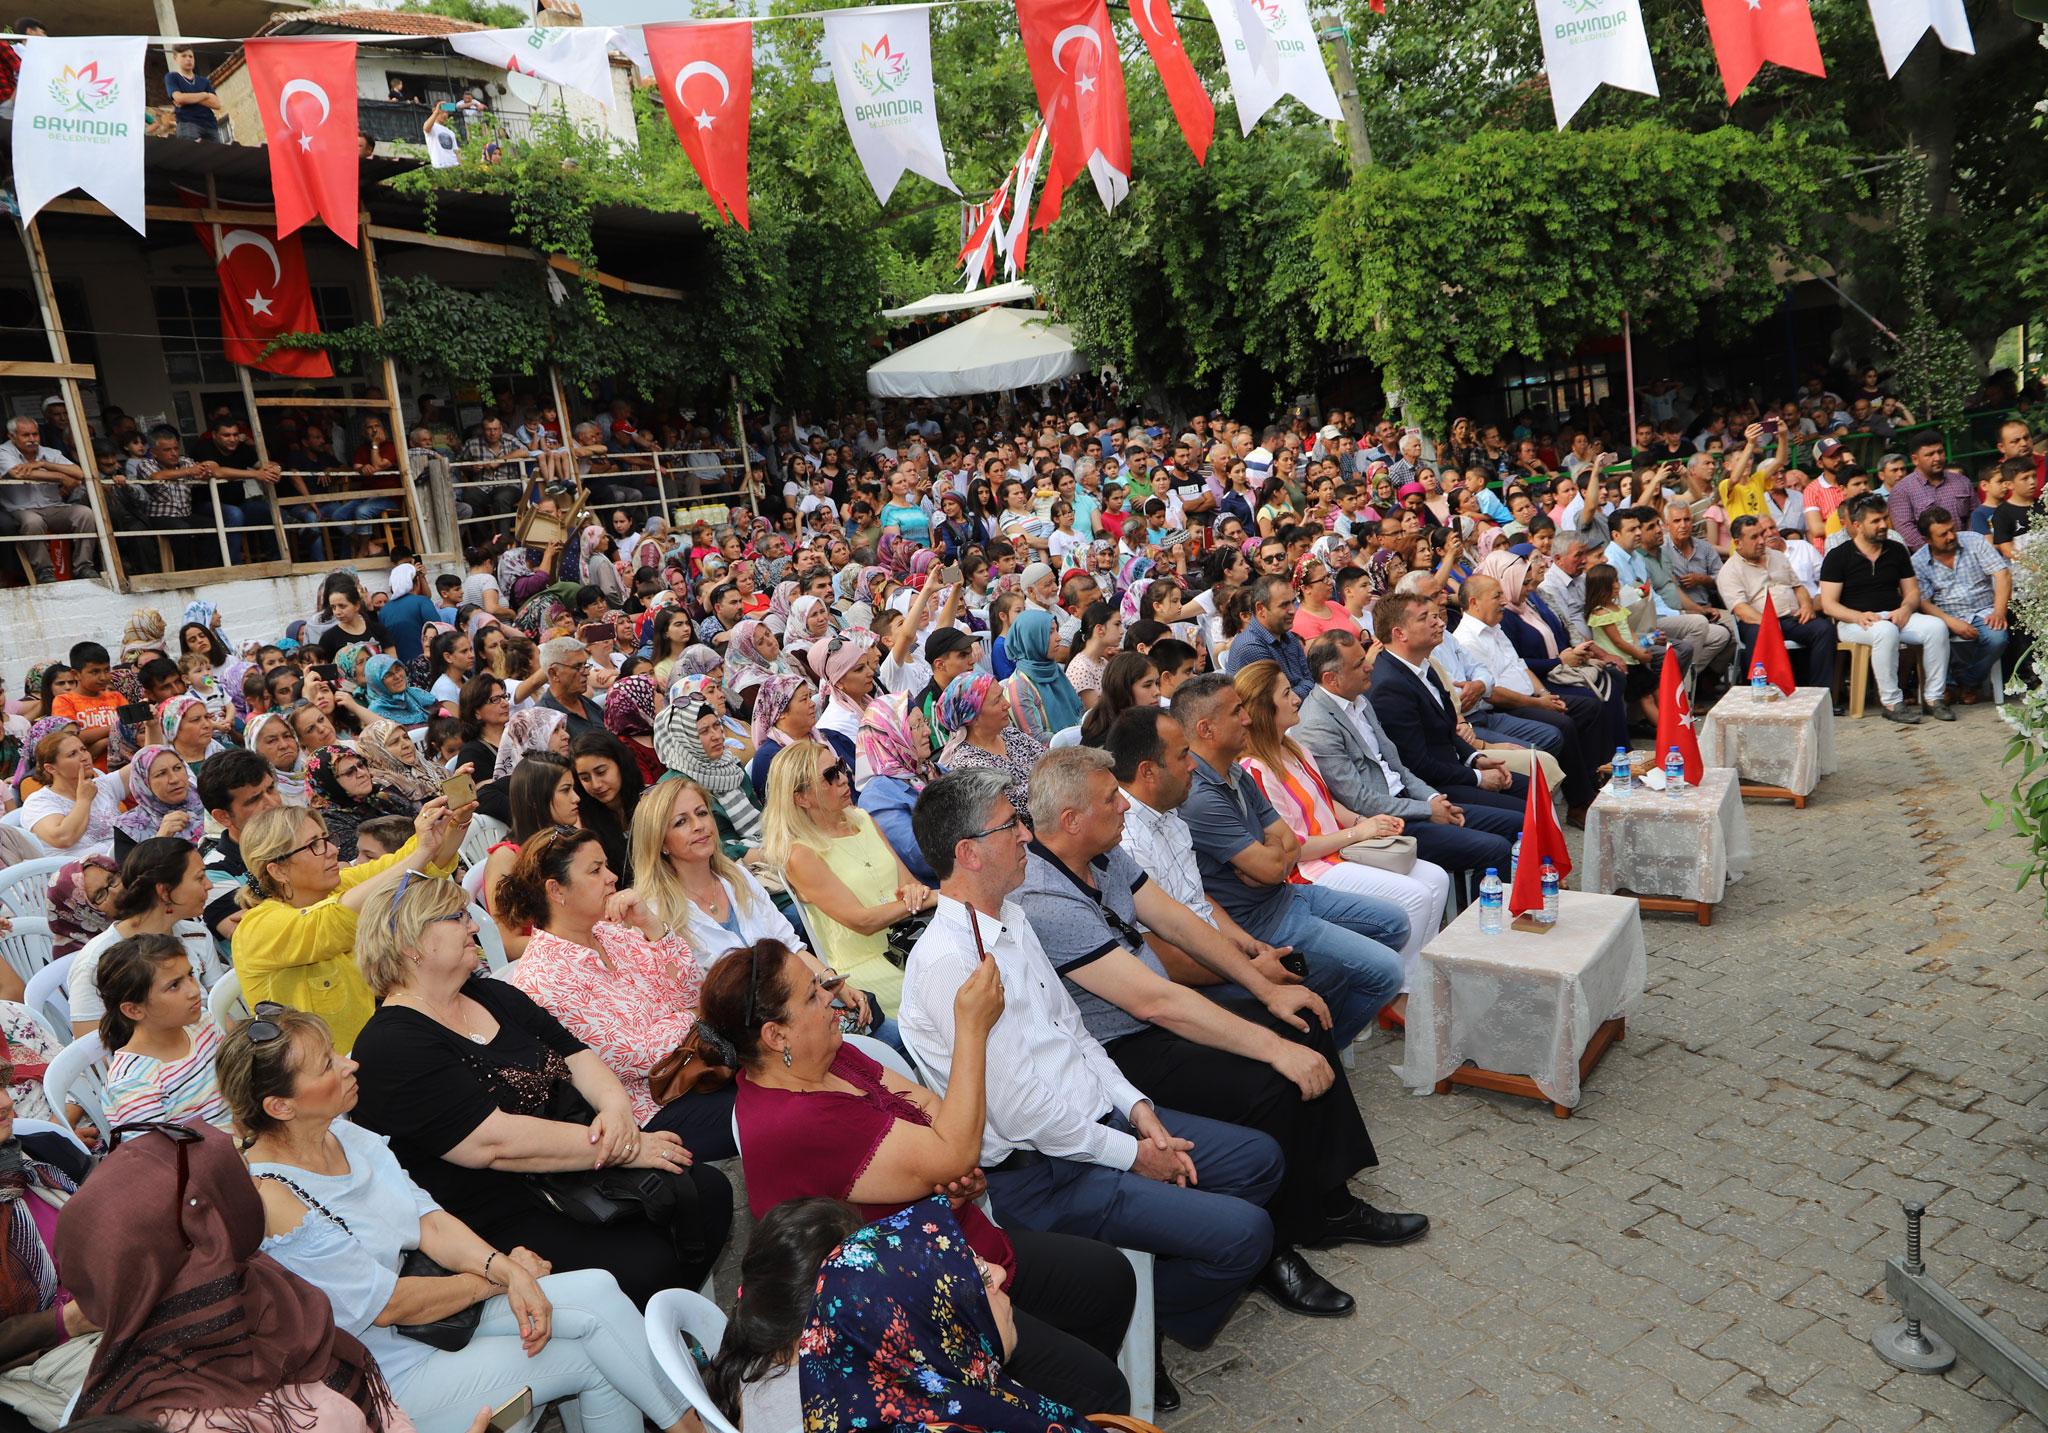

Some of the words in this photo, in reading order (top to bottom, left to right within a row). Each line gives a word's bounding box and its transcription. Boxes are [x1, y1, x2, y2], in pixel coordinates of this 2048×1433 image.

[1555, 10, 1627, 39] BAYINDIR
[855, 99, 923, 121] BAYINDIR
[33, 115, 128, 137] BAYINDIR
